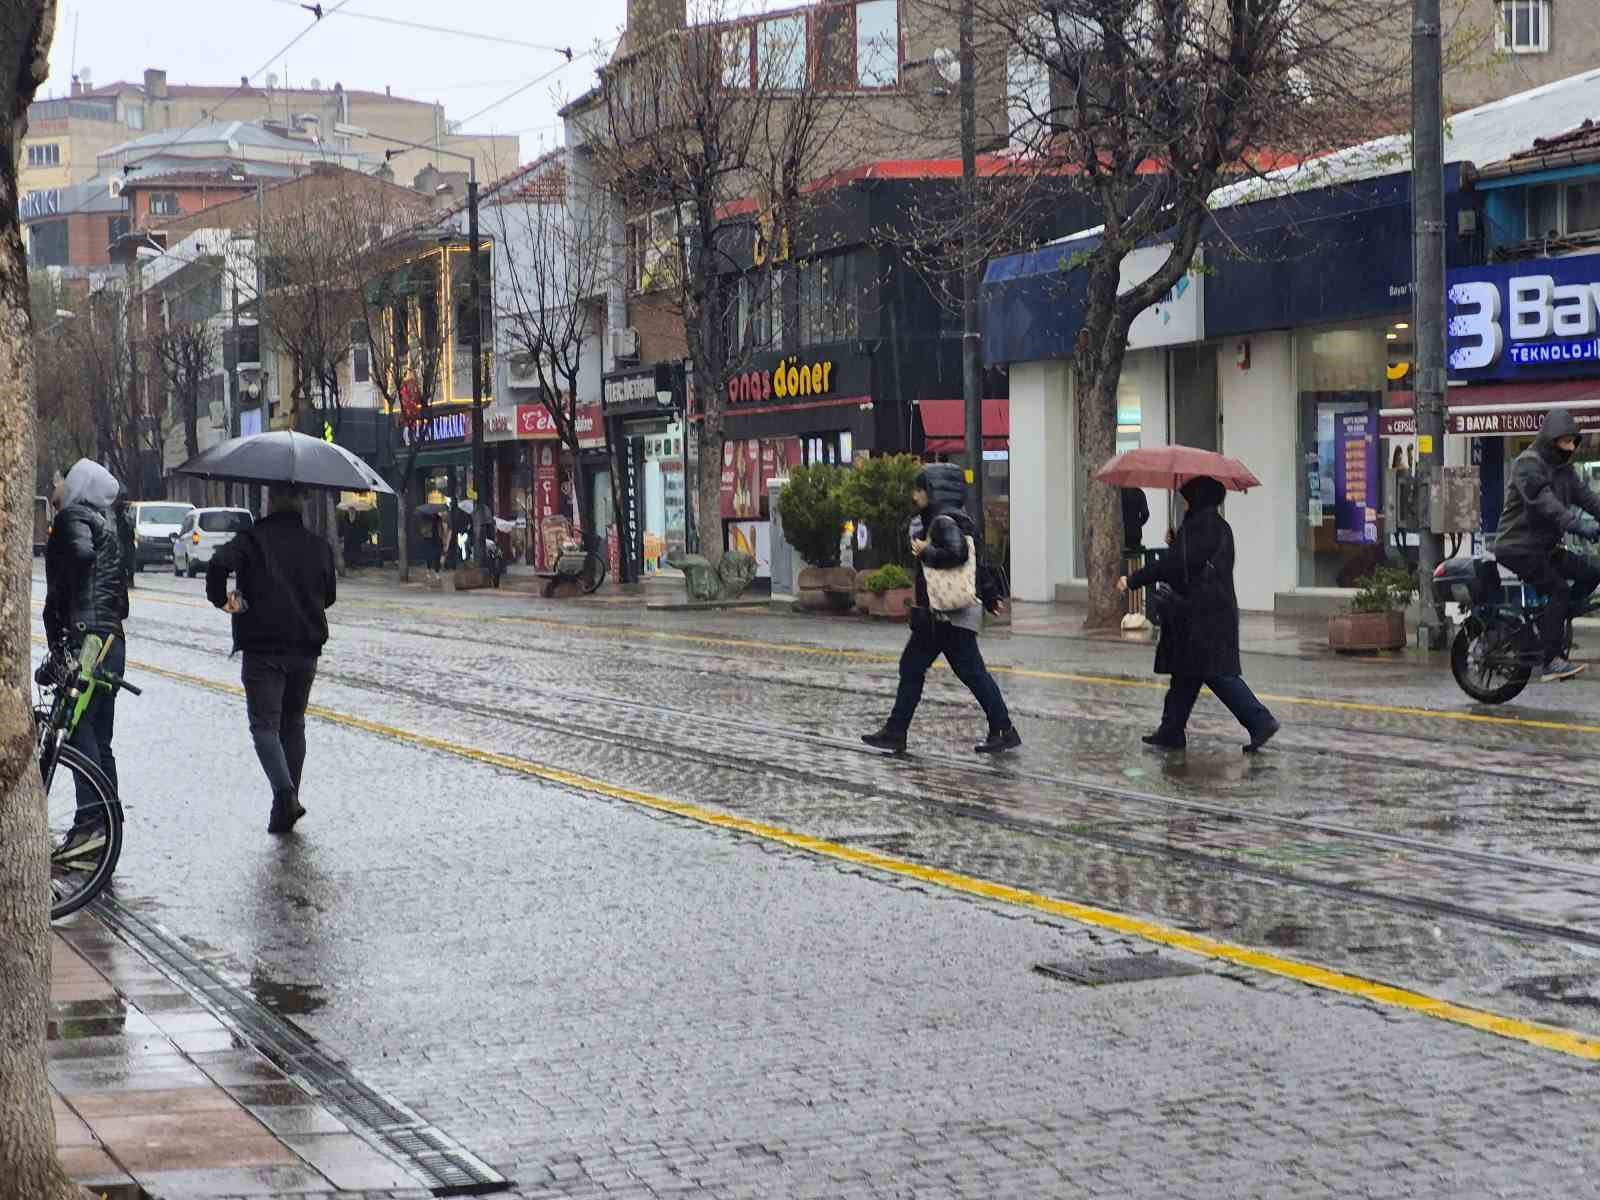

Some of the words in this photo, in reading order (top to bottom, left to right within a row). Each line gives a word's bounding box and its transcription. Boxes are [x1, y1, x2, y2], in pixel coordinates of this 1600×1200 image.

[773, 355, 832, 398] döner
[1466, 415, 1499, 431] BAYAR
[1501, 413, 1545, 430] TEKNOLO
